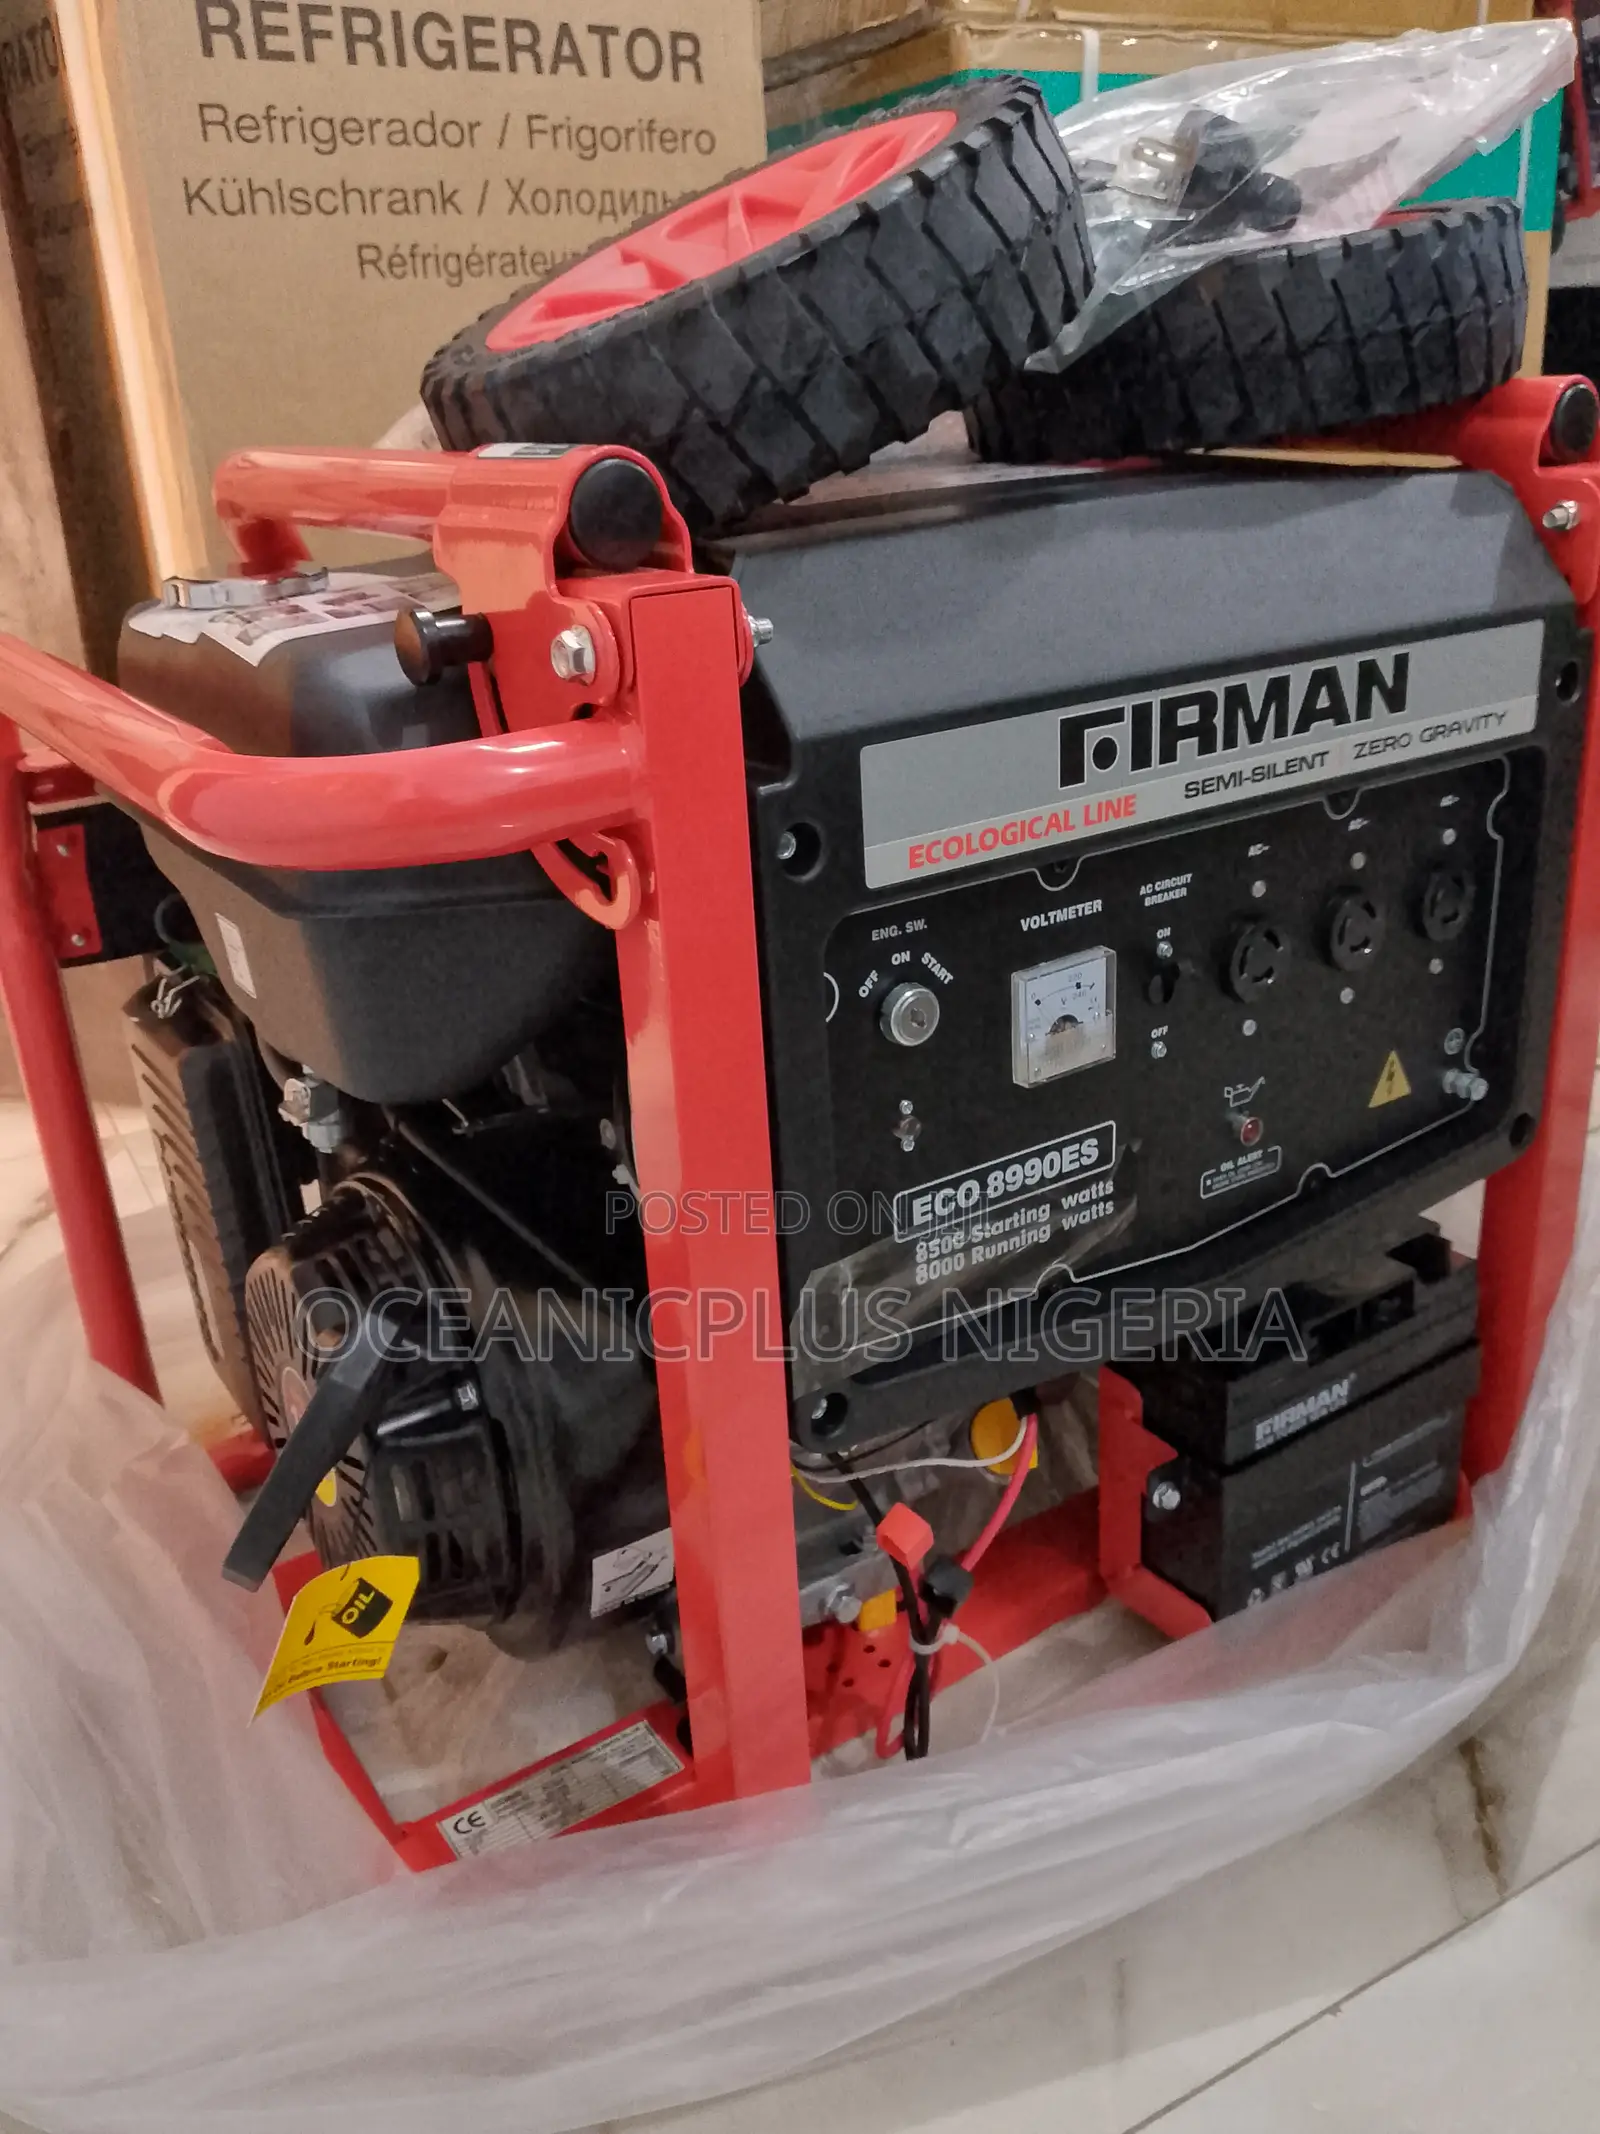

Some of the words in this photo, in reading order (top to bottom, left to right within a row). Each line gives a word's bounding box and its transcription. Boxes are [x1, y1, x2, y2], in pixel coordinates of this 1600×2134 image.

[194, 0, 705, 84] REFRIGERATOR
[198, 103, 482, 156] Refrigerador
[497, 112, 511, 150] /
[526, 113, 716, 161] Frigorifero
[182, 176, 464, 217] Kühlschrank
[477, 179, 489, 216] /
[1058, 651, 1411, 790] FIRMAN
[1184, 751, 1330, 799] SEMI-SILENT
[1353, 732, 1412, 761] ZERO
[1419, 710, 1508, 745] GRAVITY
[907, 802, 1076, 869] ECOLOGICAL
[1083, 793, 1138, 828] LINE
[1140, 883, 1153, 896] AC
[1155, 873, 1193, 892] CIRCUIT
[1144, 887, 1187, 907] BREAKER
[871, 925, 902, 942] ENG.
[905, 918, 928, 934] SW.
[1020, 899, 1103, 932] VOLTMETER
[1156, 927, 1171, 939] ON
[891, 950, 911, 966] ON
[921, 952, 954, 985] START
[858, 969, 878, 998] OFF
[1151, 1025, 1169, 1040] OFF
[912, 1180, 980, 1226] ECO
[987, 1138, 1099, 1199] 8990ES
[971, 1203, 1051, 1244] Starting
[1061, 1180, 1114, 1210] watts
[915, 1252, 965, 1285] 8000
[971, 1224, 1051, 1265] Running
[1061, 1201, 1115, 1232] watts
[341, 1590, 376, 1625] OIL
[453, 1811, 487, 1835] CE
